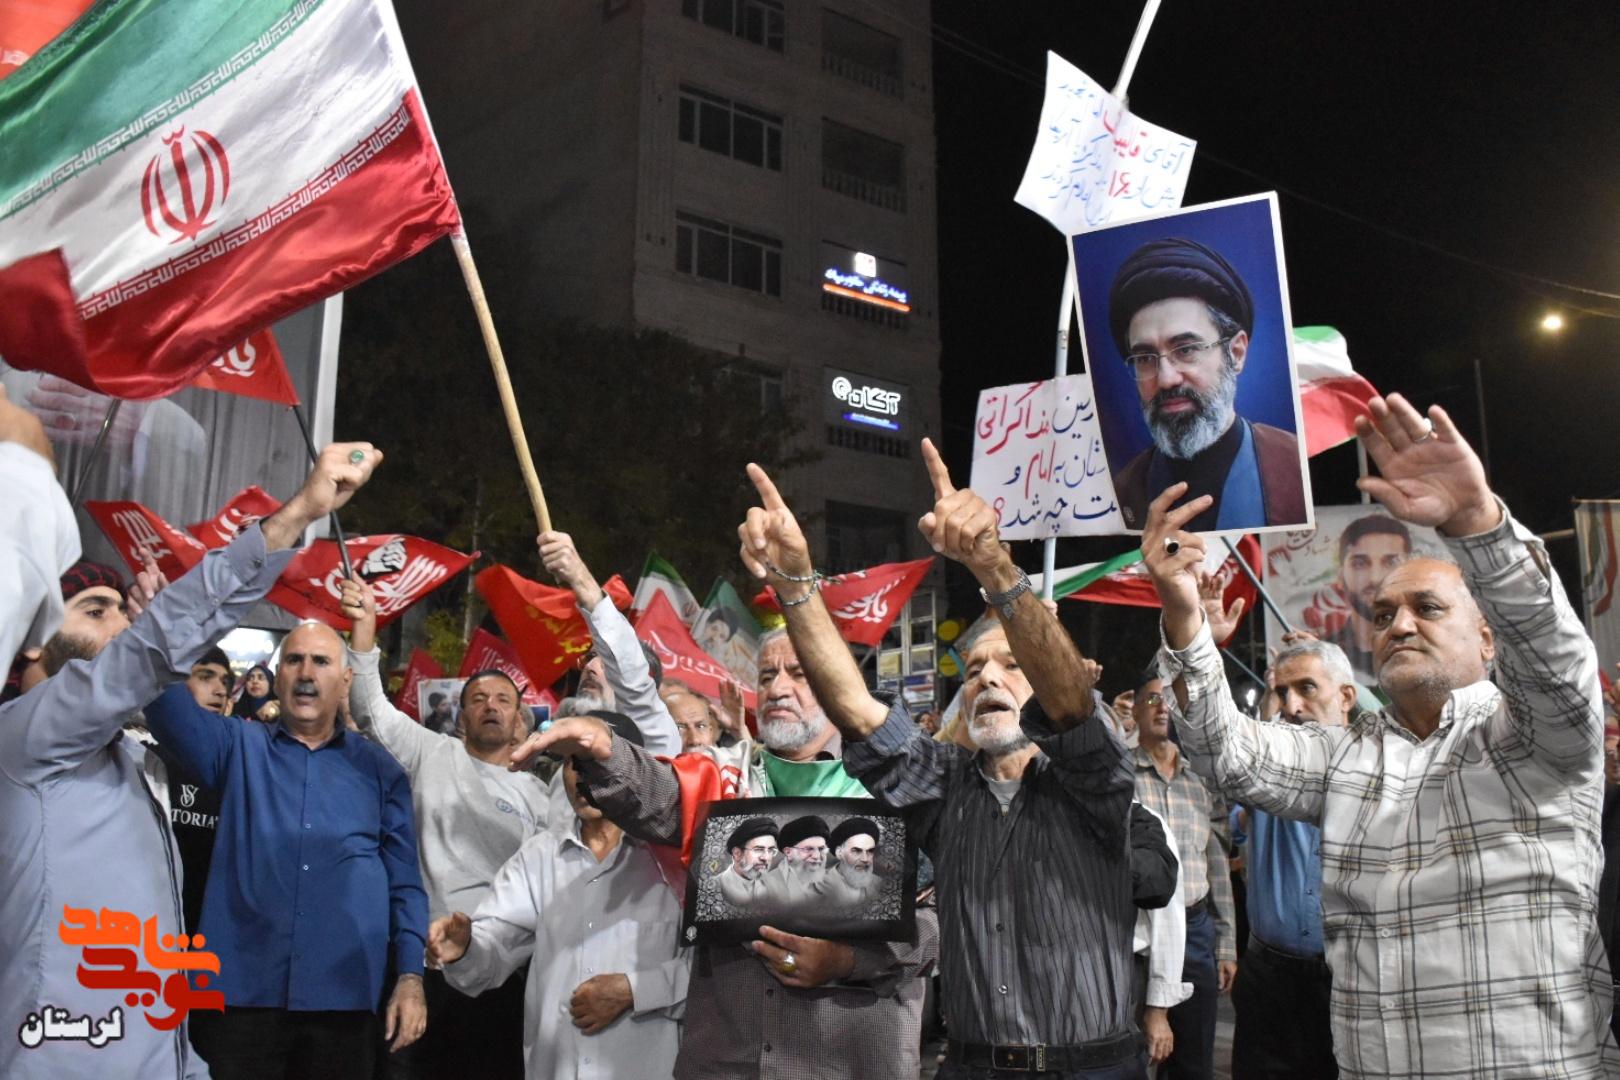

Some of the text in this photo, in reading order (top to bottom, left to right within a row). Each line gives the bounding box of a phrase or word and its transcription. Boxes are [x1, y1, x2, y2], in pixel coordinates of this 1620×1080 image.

[1001, 465, 1021, 486] و
[1024, 440, 1056, 499] امام
[1043, 497, 1068, 533] چه
[171, 808, 219, 829] TORIA'
